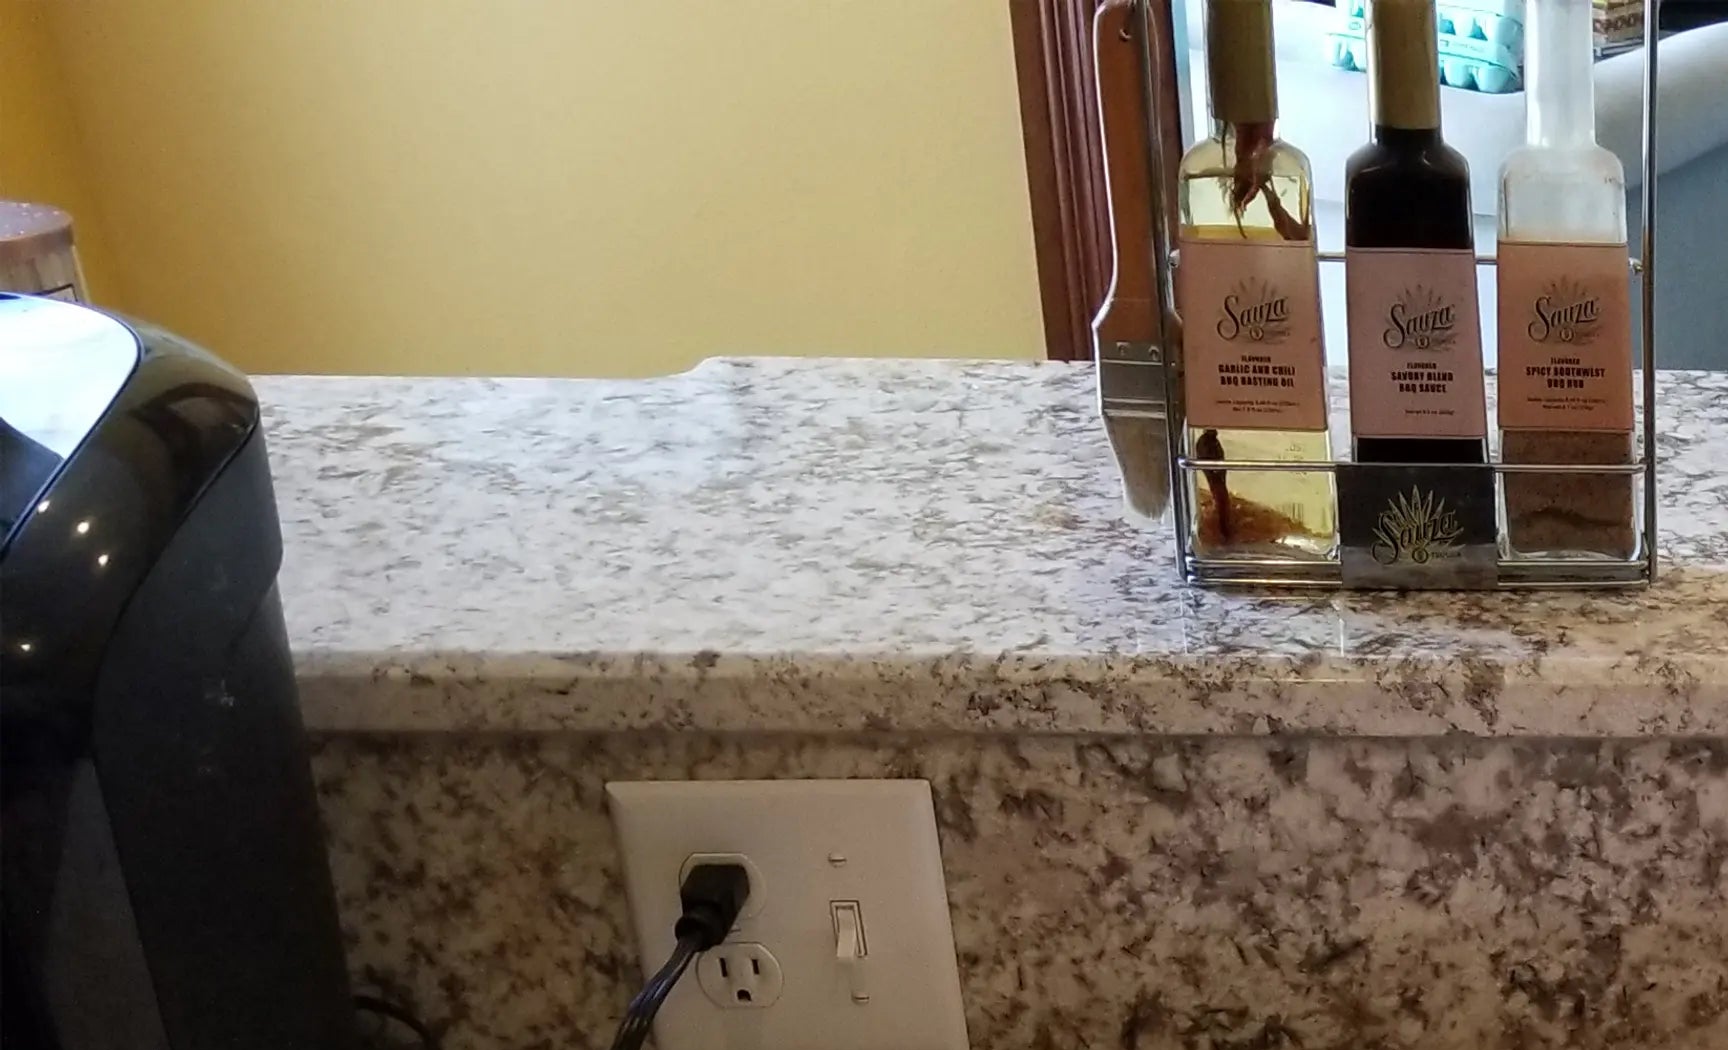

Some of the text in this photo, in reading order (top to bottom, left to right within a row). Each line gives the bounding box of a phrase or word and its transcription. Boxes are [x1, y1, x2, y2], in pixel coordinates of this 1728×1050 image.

[1217, 295, 1289, 341] Sauza
[1529, 296, 1600, 342] Sauza
[1383, 303, 1456, 349] Sauza
[1218, 364, 1250, 374] GARLIC
[1252, 365, 1269, 375] AND
[1525, 366, 1605, 377] SPICY SOUTHWEST
[1391, 371, 1425, 381] SAVORY
[1281, 378, 1295, 388] OIL
[1418, 384, 1448, 394] SAUCE
[1372, 511, 1458, 565] Sauza
